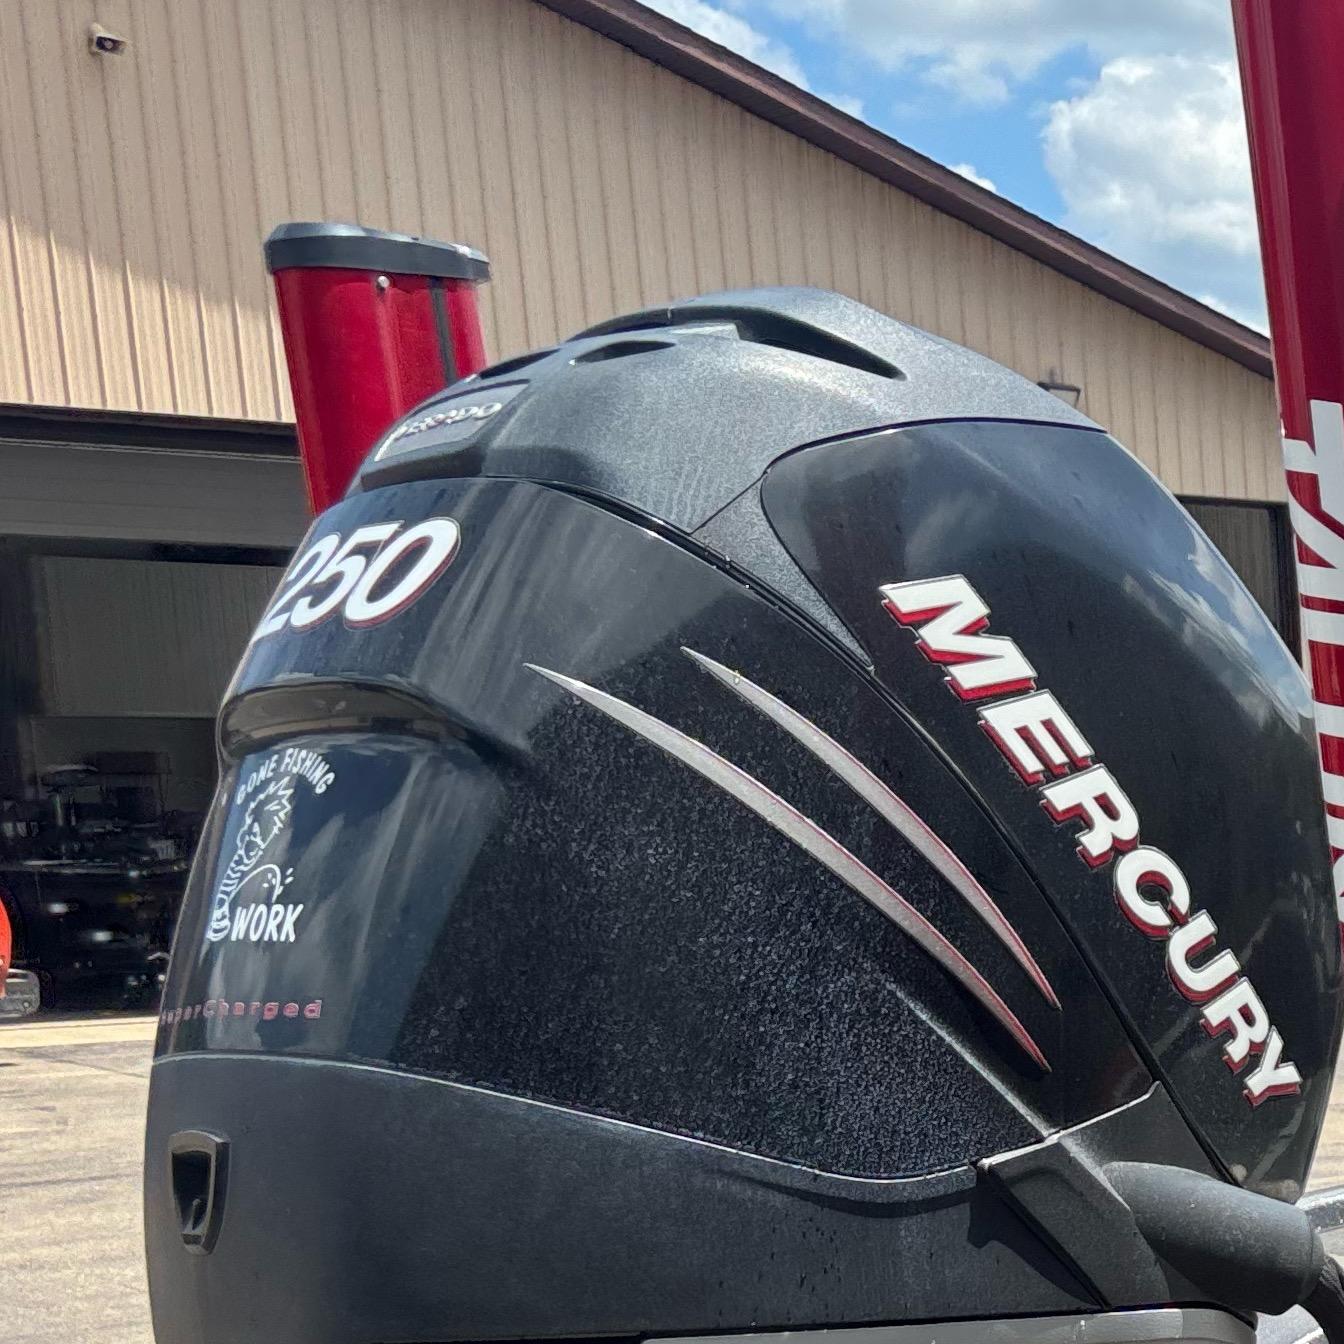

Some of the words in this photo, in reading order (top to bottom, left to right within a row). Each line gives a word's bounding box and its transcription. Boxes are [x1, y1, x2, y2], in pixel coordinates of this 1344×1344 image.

[248, 516, 461, 643] 250
[280, 747, 336, 795] FISHING
[879, 574, 1301, 1107] MERCURY
[231, 903, 304, 942] WORK
